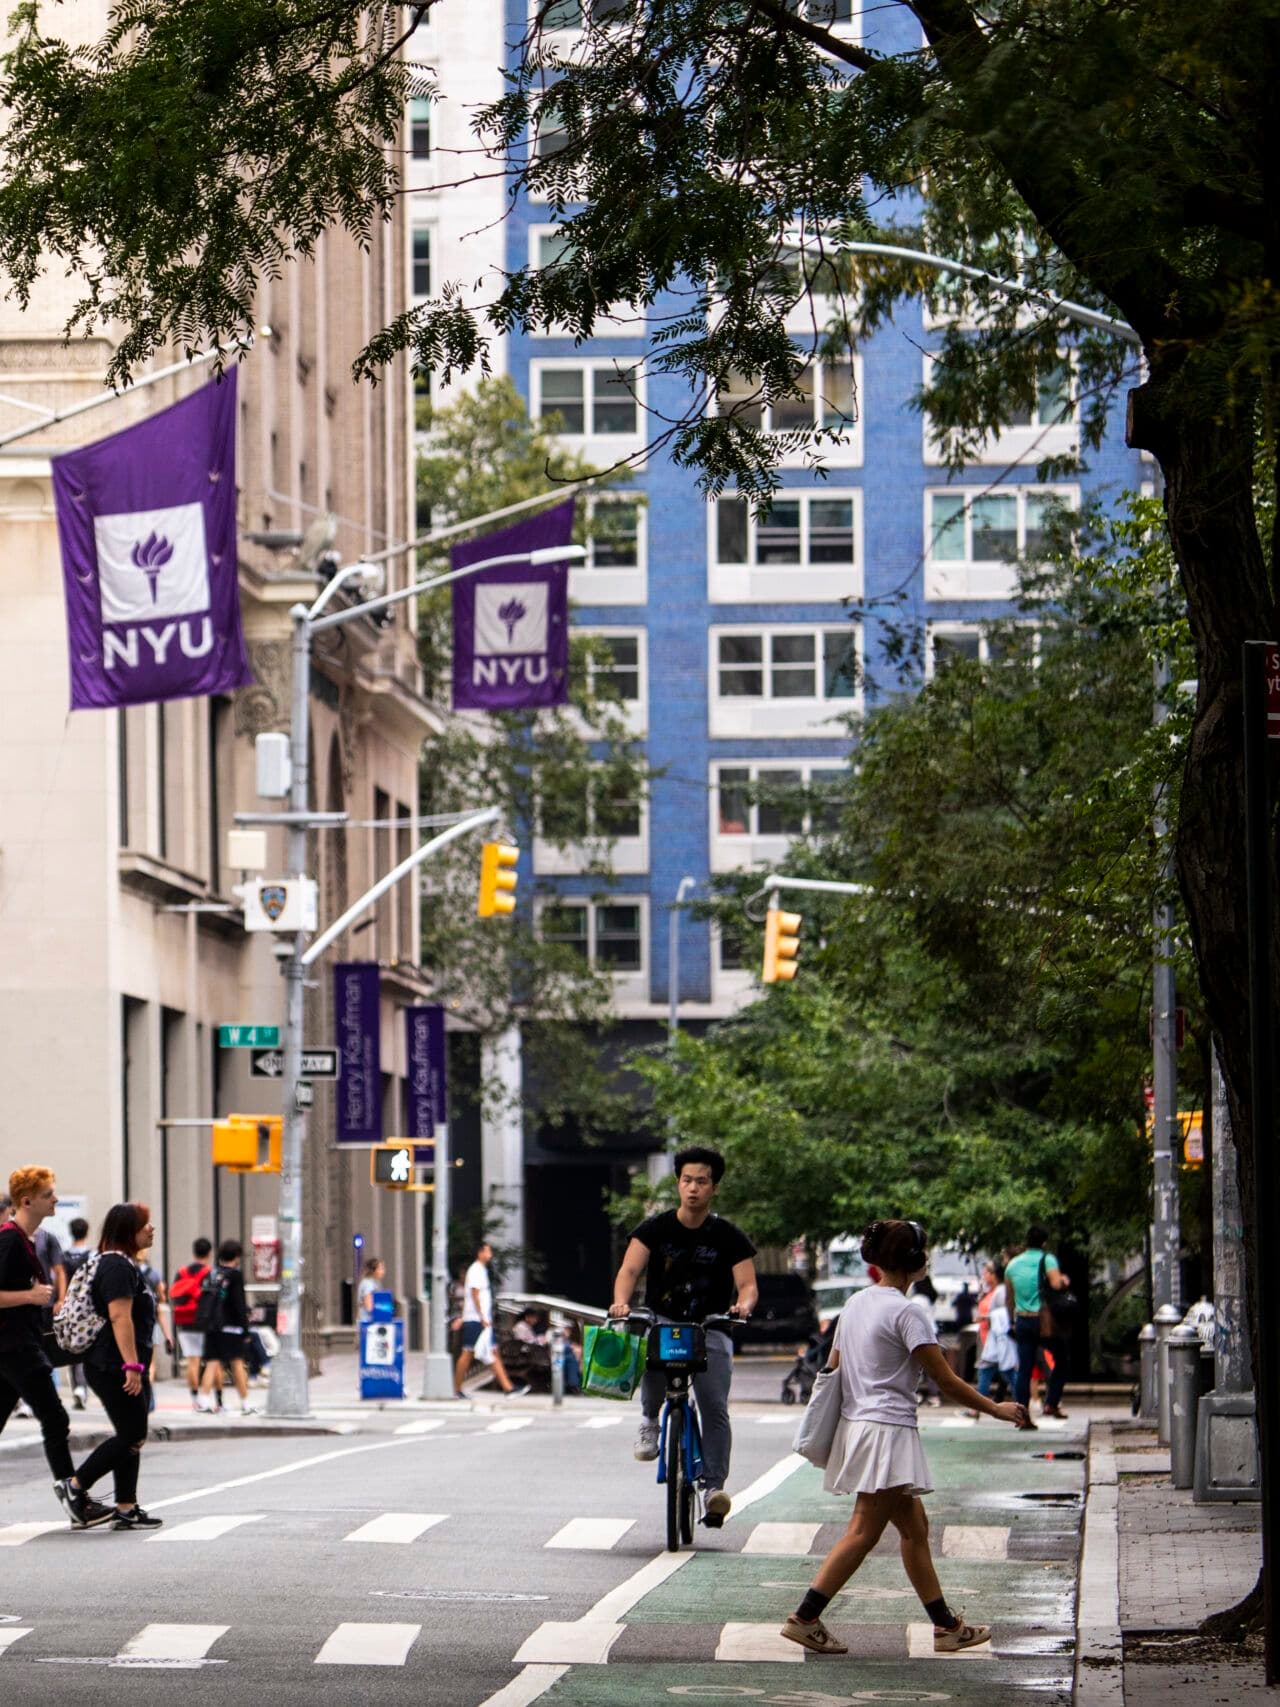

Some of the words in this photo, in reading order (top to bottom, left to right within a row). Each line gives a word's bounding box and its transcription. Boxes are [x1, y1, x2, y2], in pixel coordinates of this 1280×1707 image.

[103, 616, 213, 669] NYU
[473, 656, 548, 686] NYU
[228, 1028, 240, 1042] W
[247, 1028, 257, 1042] 4
[342, 974, 361, 1065] Kaufman
[343, 1070, 364, 1130] Henry
[414, 1097, 431, 1140] enry
